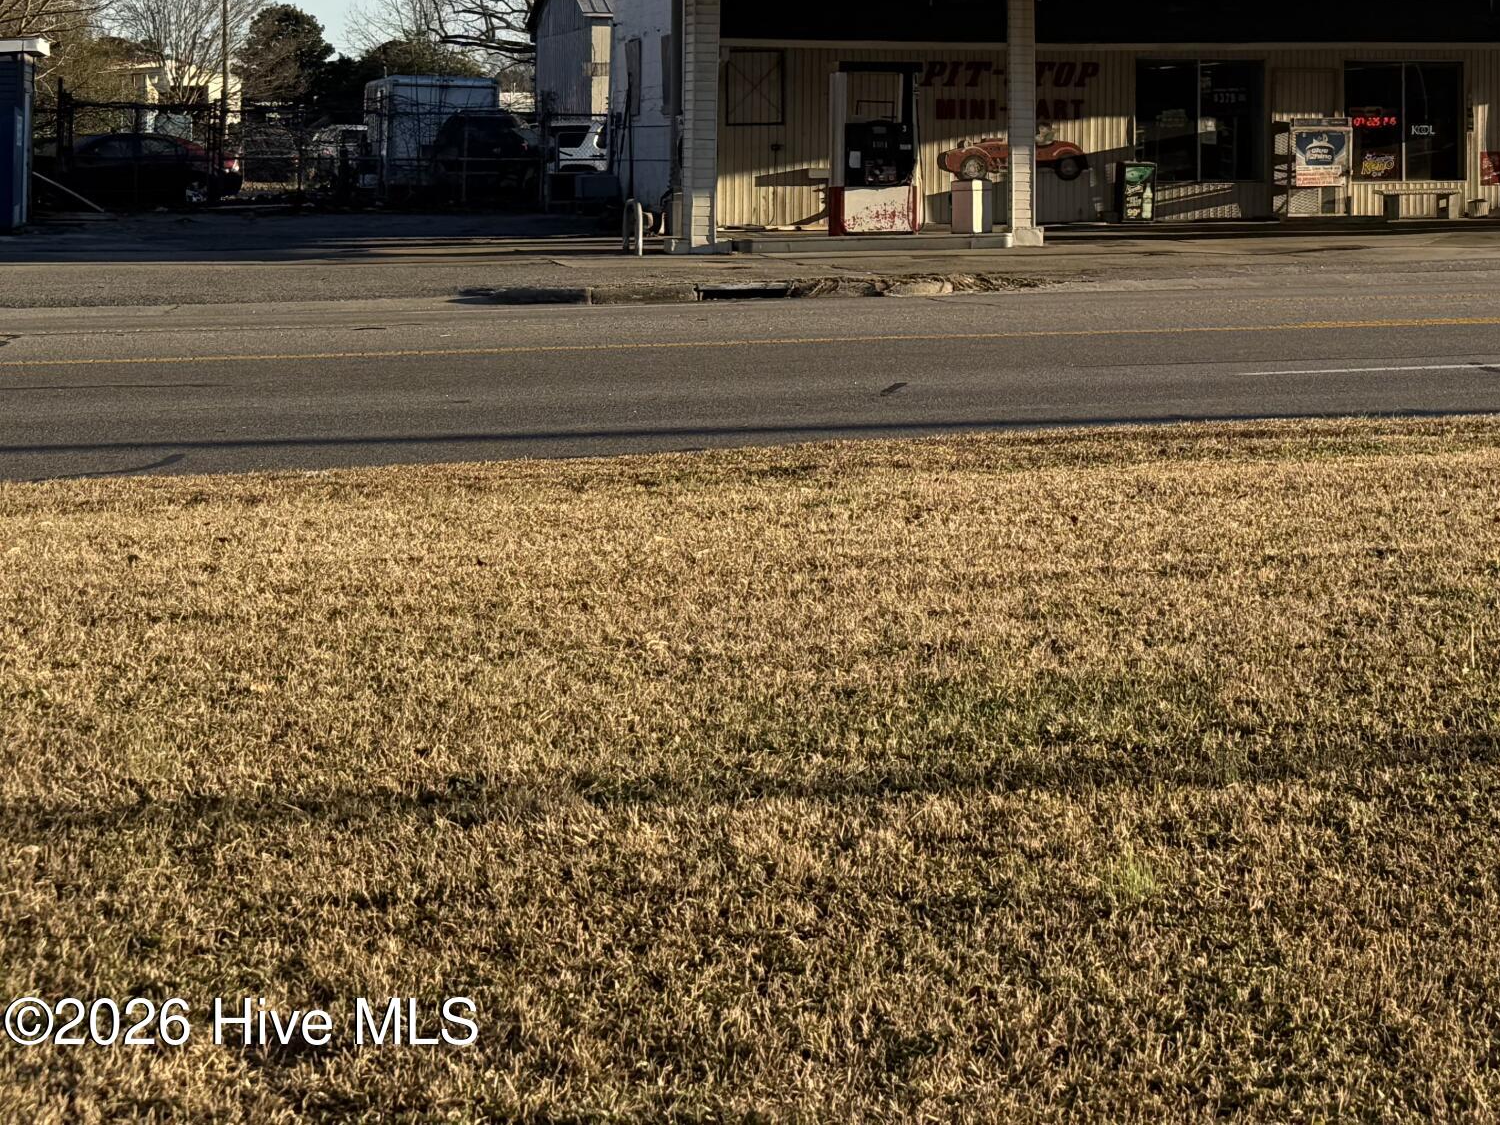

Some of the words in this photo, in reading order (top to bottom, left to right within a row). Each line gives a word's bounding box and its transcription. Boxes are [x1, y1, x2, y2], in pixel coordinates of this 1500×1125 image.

[919, 60, 1100, 88] PIT-TOP
[936, 98, 1085, 120] MINI-ART
[1411, 124, 1436, 135] KOOL
